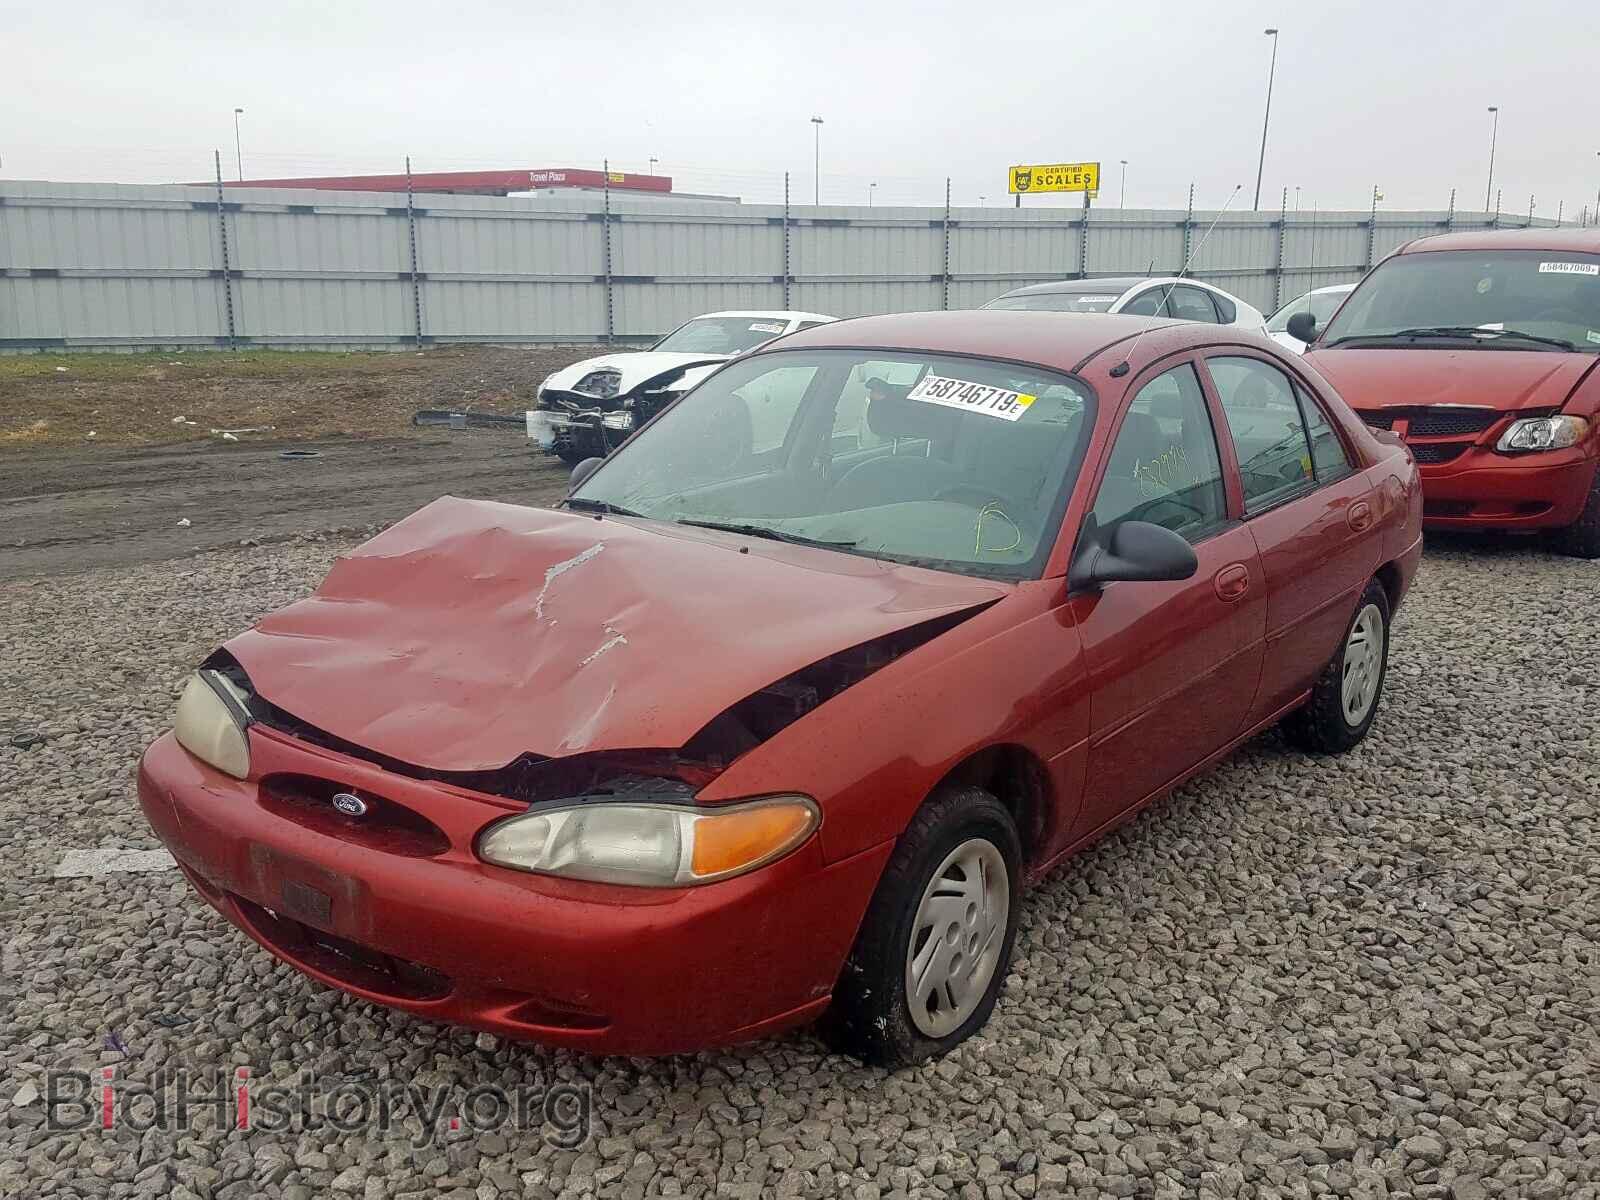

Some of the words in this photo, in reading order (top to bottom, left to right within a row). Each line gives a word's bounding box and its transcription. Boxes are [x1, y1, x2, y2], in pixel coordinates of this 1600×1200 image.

[1045, 166, 1082, 175] CERTIFIED
[529, 171, 547, 182] Travel
[549, 171, 566, 182] Plaza
[1017, 175, 1028, 185] CAT
[1036, 173, 1091, 186] SCALES
[338, 797, 357, 813] Ford
